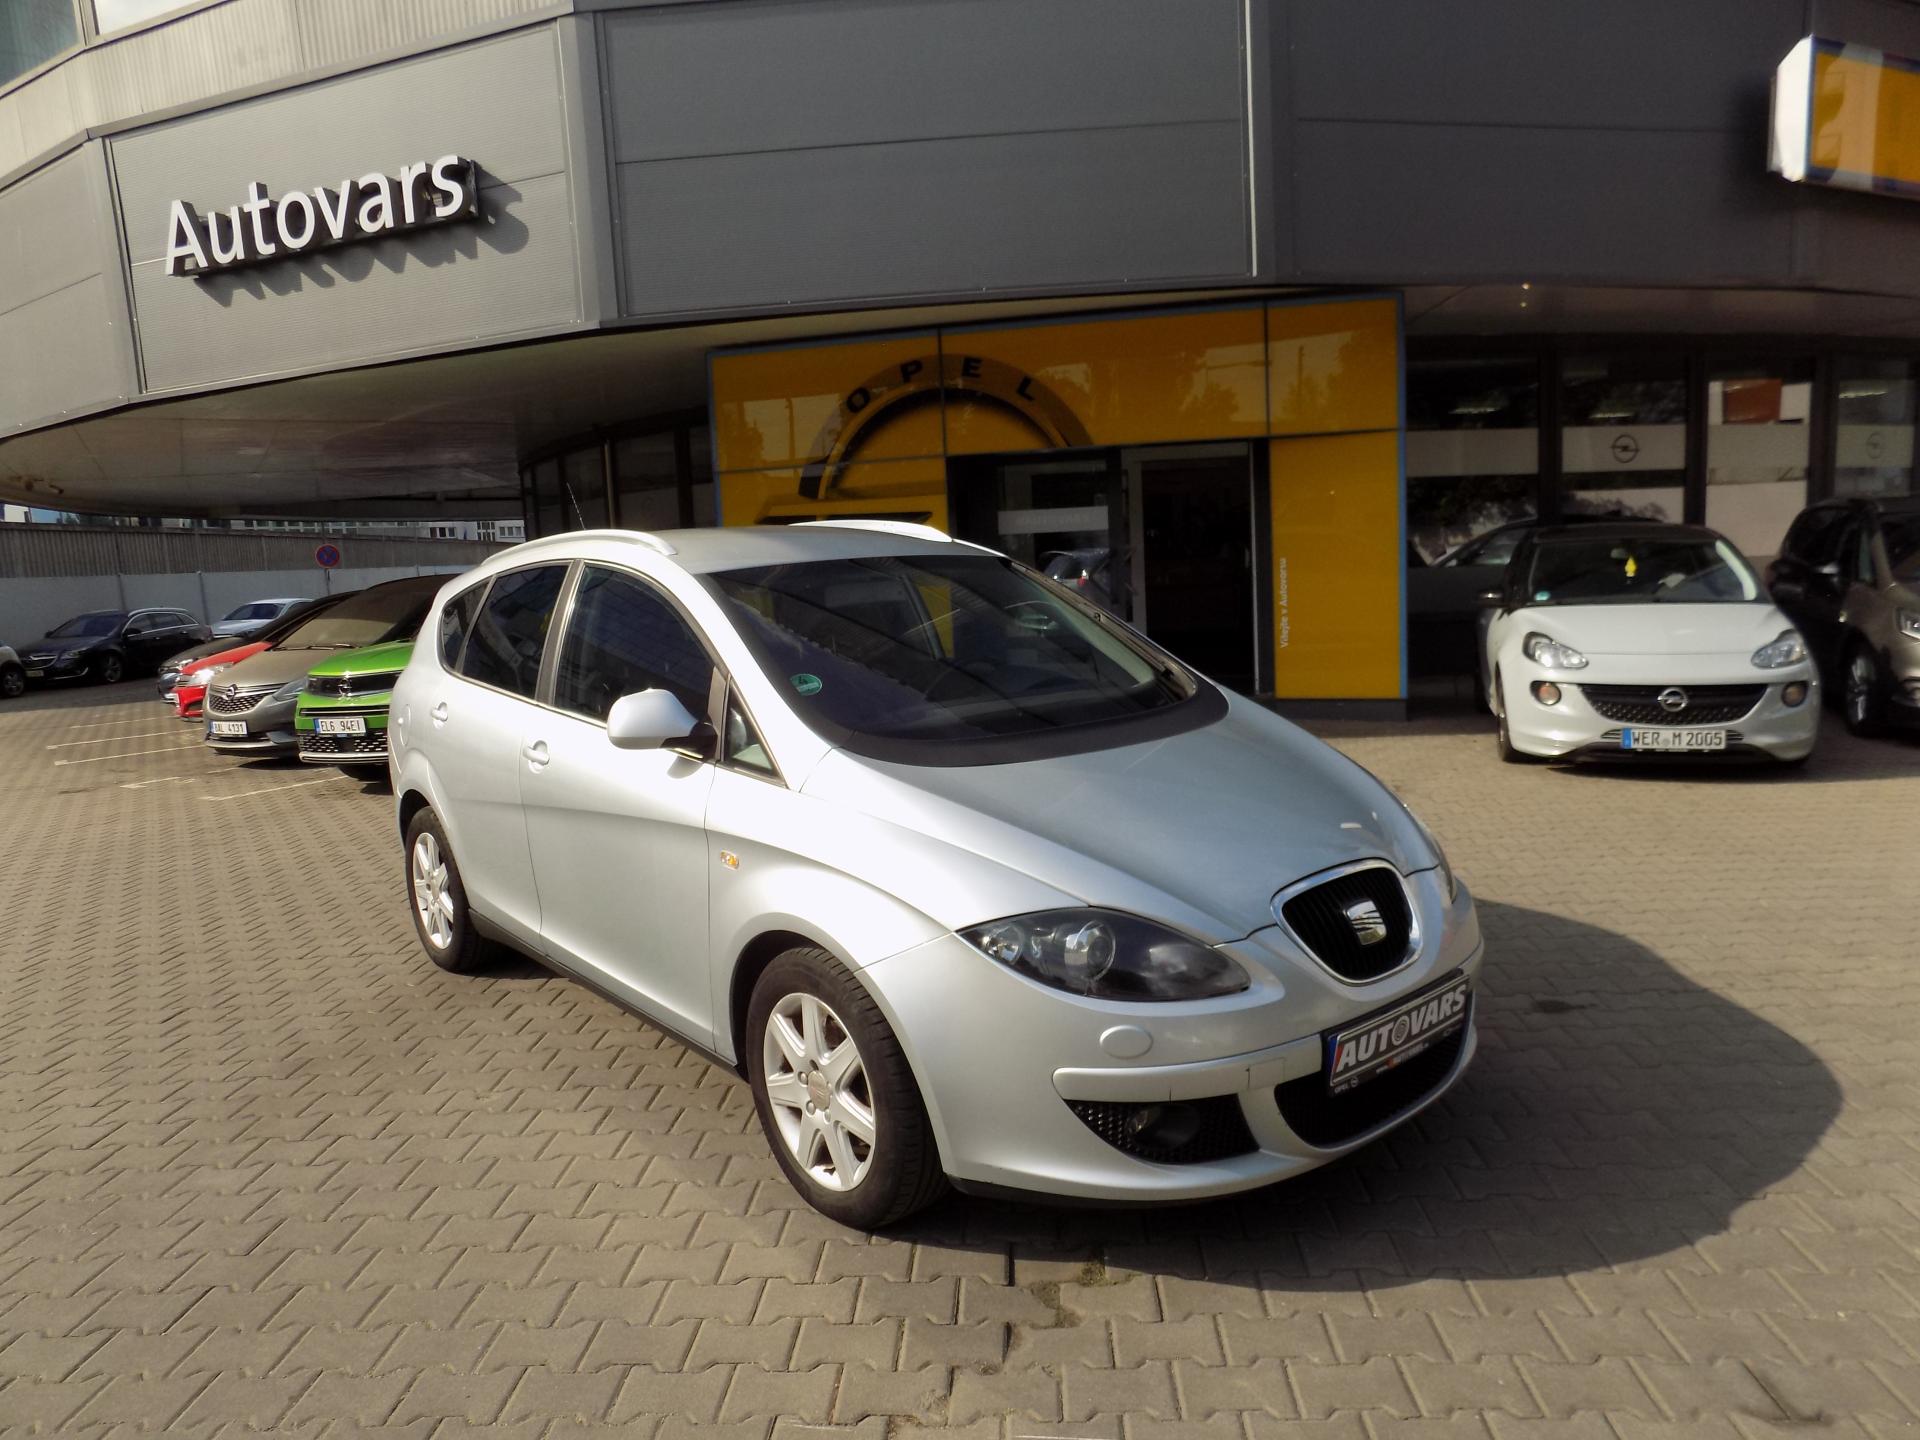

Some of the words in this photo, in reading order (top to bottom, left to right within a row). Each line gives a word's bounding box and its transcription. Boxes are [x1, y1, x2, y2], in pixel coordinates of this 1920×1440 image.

[165, 155, 466, 275] Autovars
[846, 356, 1035, 414] OPEL
[1632, 731, 1660, 745] WER
[1672, 732, 1682, 746] M
[1686, 732, 1722, 746] 2005
[1336, 984, 1467, 1073] AUTOVARS
